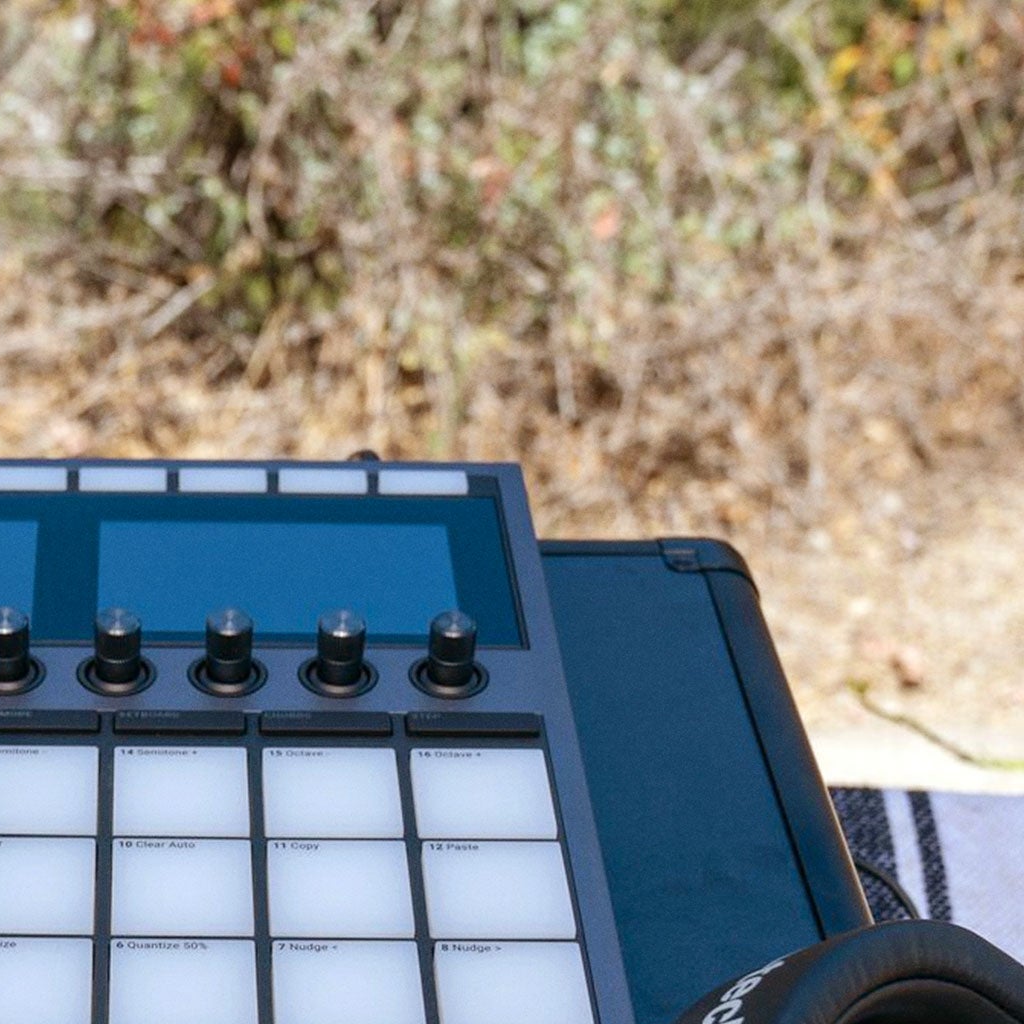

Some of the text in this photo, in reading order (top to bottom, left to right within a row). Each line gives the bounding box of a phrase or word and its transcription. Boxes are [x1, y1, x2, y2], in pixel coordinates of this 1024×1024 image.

[290, 842, 320, 850] Copy
[447, 843, 479, 851] Paste
[116, 941, 208, 950] 6 Quantize 50%
[290, 943, 328, 952] Nudge
[452, 944, 491, 953] Nudge
